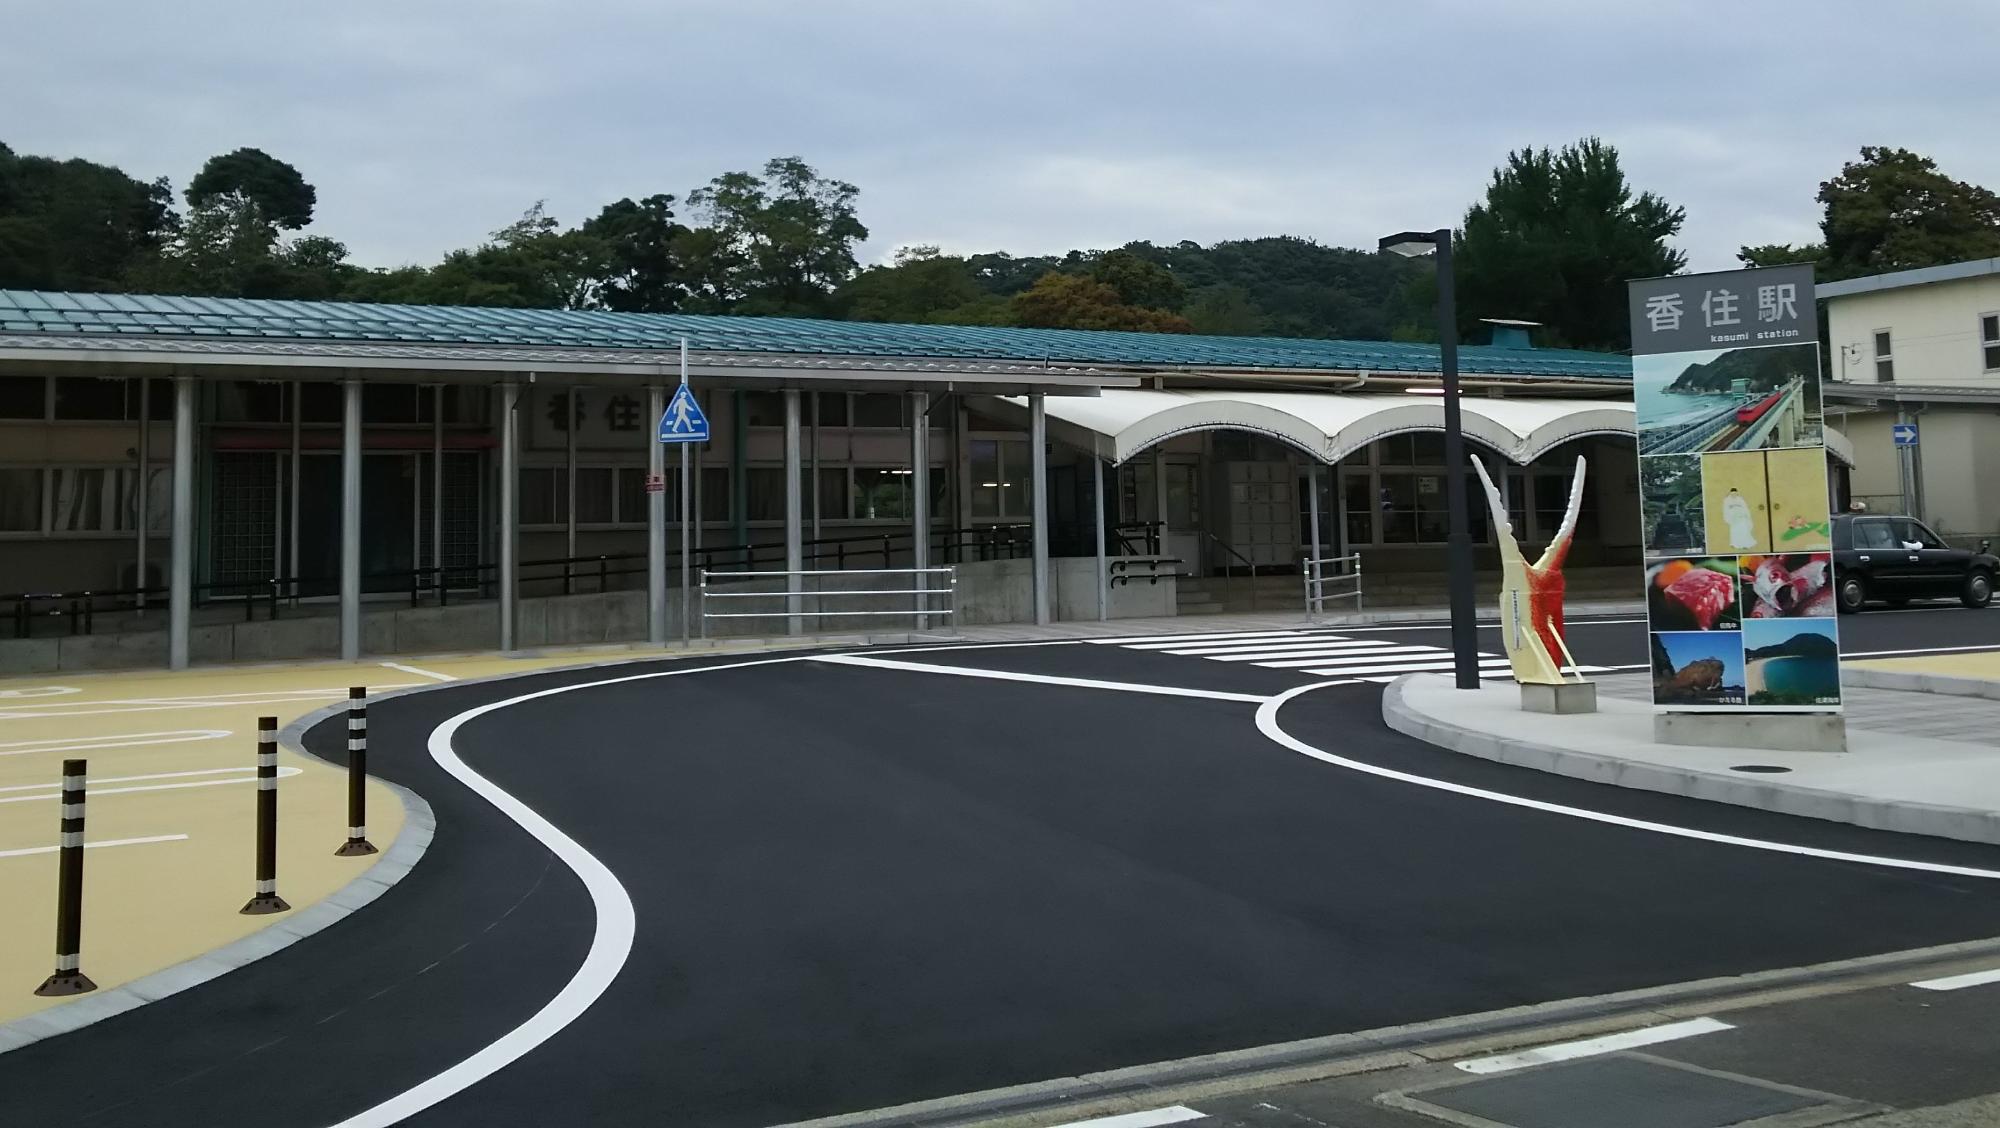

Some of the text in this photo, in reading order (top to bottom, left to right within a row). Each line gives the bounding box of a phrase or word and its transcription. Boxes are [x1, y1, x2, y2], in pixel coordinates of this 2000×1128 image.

[1646, 283, 1798, 332] 香住駅
[1710, 328, 1799, 343] kasumi station
[547, 392, 672, 431] 香住
